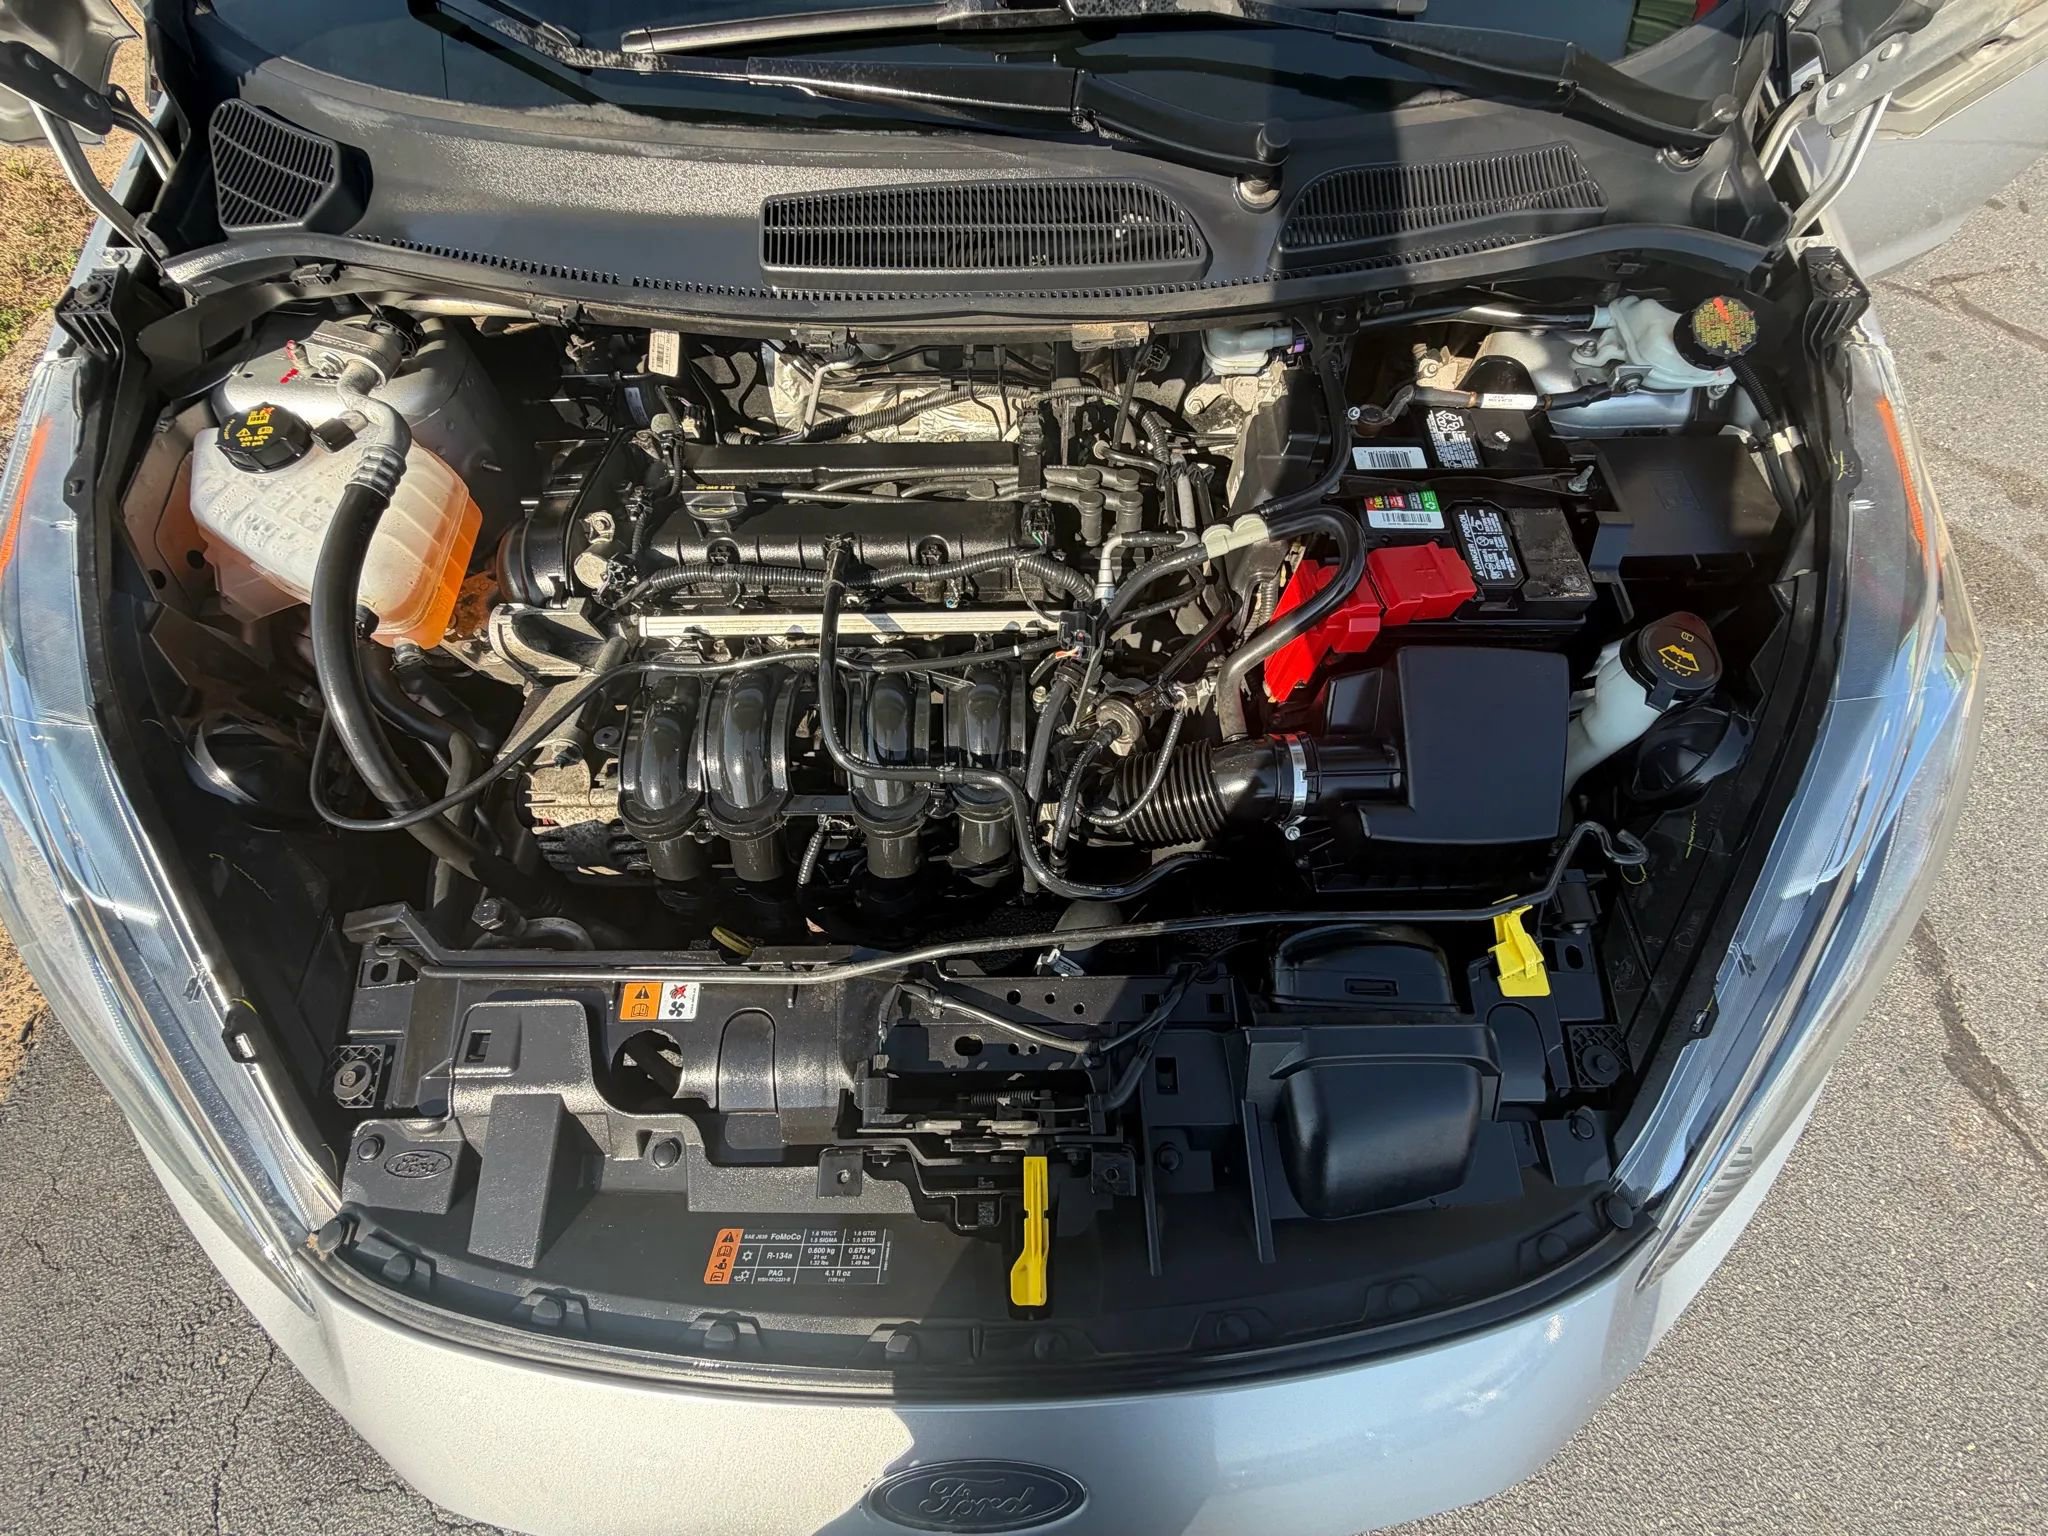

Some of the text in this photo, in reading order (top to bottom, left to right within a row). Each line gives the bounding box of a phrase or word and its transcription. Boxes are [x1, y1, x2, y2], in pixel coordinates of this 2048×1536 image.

[1458, 514, 1472, 538] POISON
[1468, 543, 1483, 570] DANGER
[396, 1153, 441, 1173] Ford
[770, 1232, 802, 1241] FoMoCo
[766, 1252, 793, 1260] R-134a
[827, 1247, 836, 1256] kg
[867, 1247, 876, 1256] kg
[767, 1269, 783, 1277] PAG
[919, 1477, 1034, 1516] Ford
